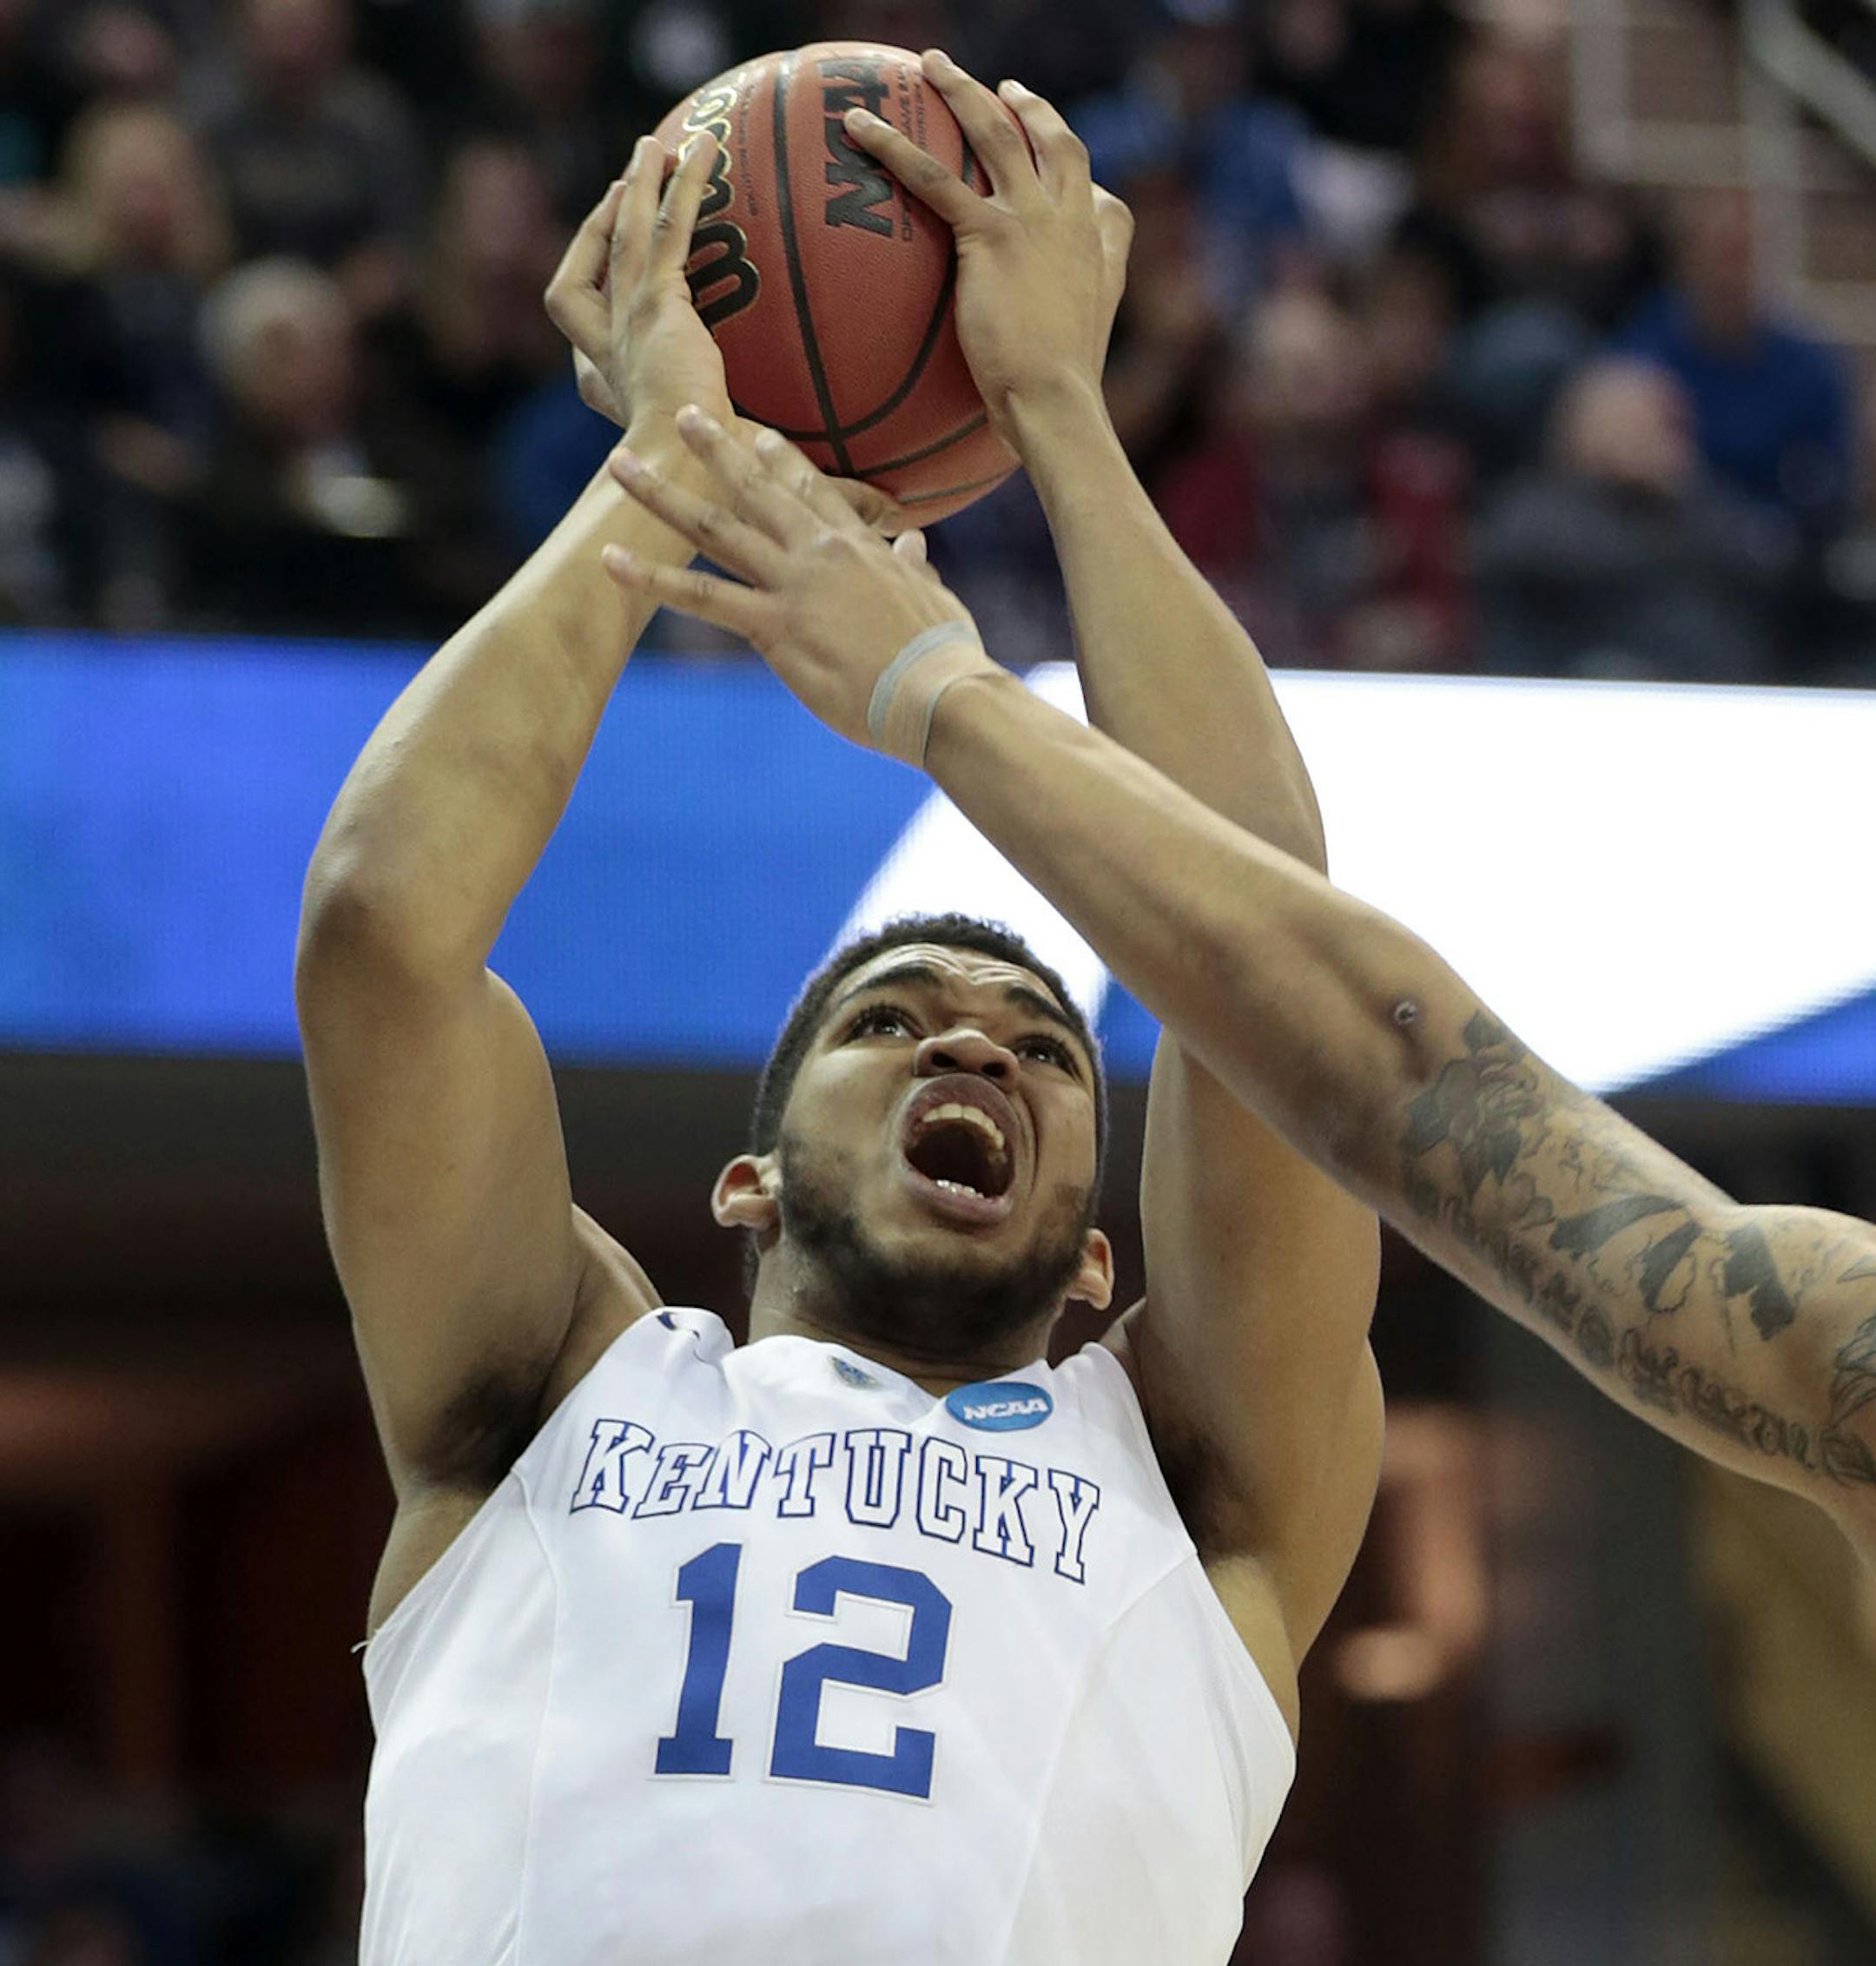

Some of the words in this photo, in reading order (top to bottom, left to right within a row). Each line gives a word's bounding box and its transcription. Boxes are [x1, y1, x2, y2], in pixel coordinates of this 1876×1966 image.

[819, 57, 894, 238] NCAA
[962, 1396, 1048, 1421] NCAA
[570, 1418, 1100, 1585] KENTUCKY
[653, 1540, 954, 1800] 12
